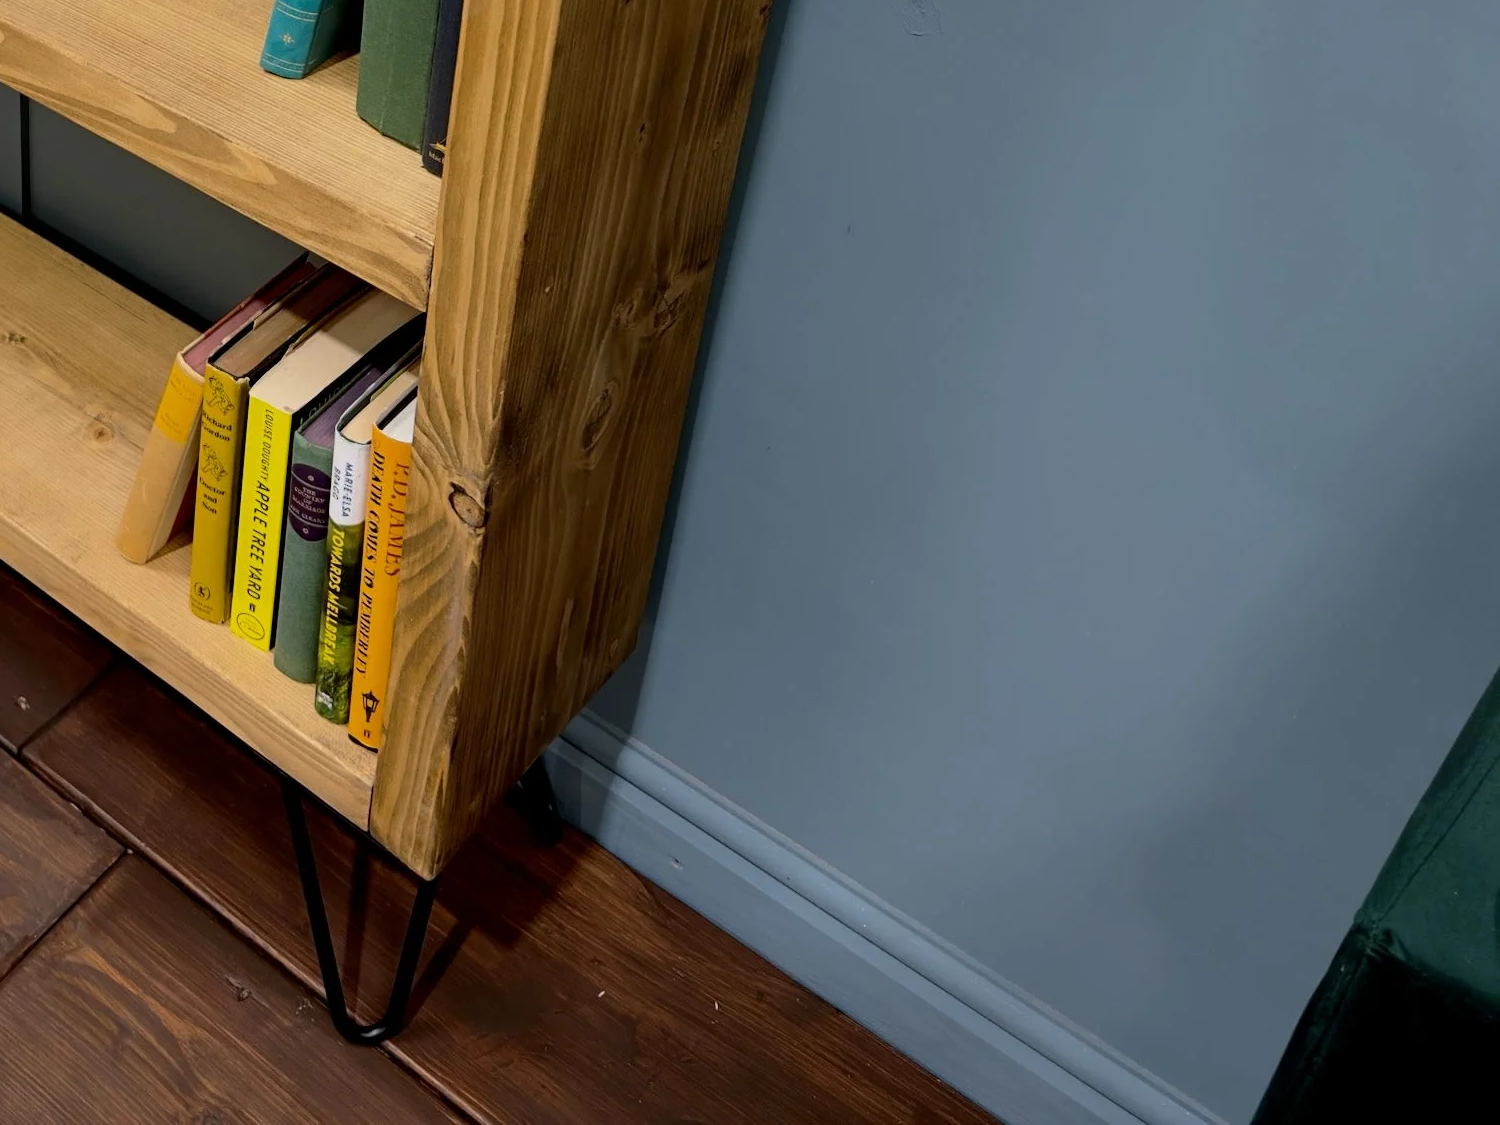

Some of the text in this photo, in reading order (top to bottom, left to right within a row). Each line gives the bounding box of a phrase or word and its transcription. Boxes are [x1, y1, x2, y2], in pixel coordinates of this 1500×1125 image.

[202, 409, 233, 432] Richard
[263, 409, 274, 442] LOUISE
[260, 442, 272, 483] DOUGHTY
[198, 476, 226, 496] Doctor
[203, 493, 218, 505] and
[294, 486, 325, 504] COUNTRY
[302, 486, 317, 496] THE
[303, 497, 313, 505] OF
[332, 466, 341, 501] BRAGG
[341, 462, 354, 517] MARIE-ELSA
[201, 500, 218, 515] Son
[253, 480, 271, 528] APPLE
[250, 528, 267, 567] TREE
[384, 499, 406, 577] JAMES
[355, 450, 386, 679] DEATH COMES TO PEMBERLEY
[246, 566, 264, 601] YARD
[322, 529, 345, 666] TOWARDS MELLBREAK
